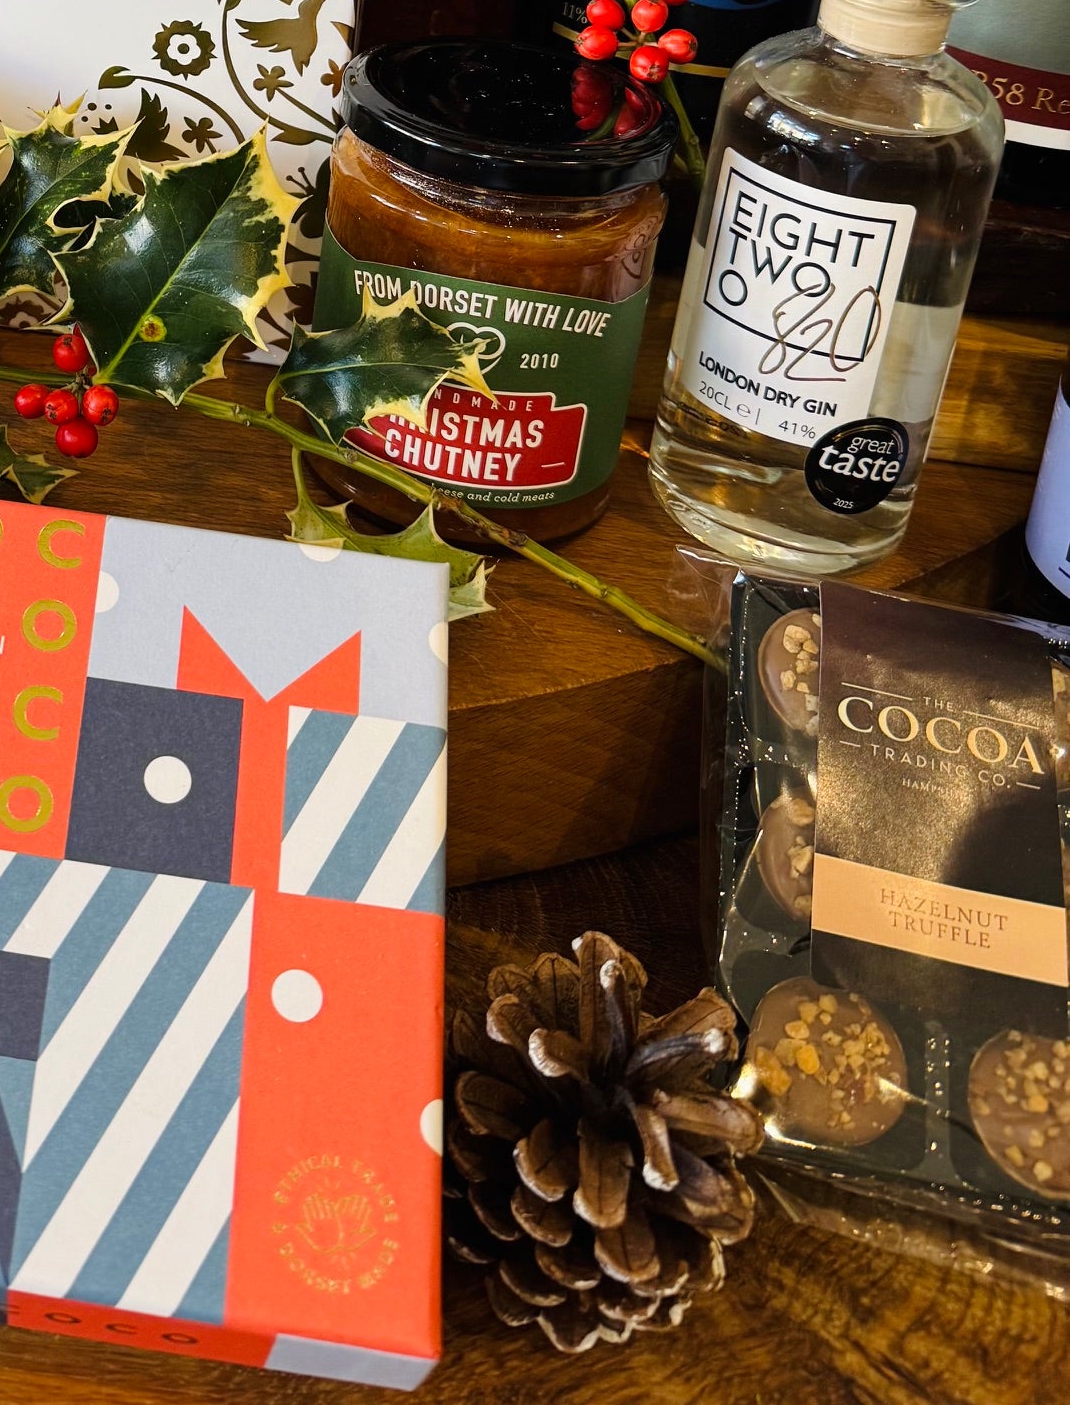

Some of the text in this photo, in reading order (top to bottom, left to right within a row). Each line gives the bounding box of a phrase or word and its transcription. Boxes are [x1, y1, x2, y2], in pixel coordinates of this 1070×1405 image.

[732, 190, 875, 268] EIGHT
[729, 226, 831, 298] TWO
[354, 269, 611, 338] FROM DORSET WITH LOVE
[520, 353, 560, 369] 2010
[699, 350, 837, 418] LONDON DRY GIN
[699, 381, 816, 440] 20CL 41%
[385, 428, 522, 482] CHUTNEY
[819, 445, 900, 483] taste
[847, 437, 896, 454] great
[467, 491, 555, 502] and cold meats
[833, 497, 854, 509] 2025
[923, 697, 954, 712] THE
[837, 696, 1045, 774] COCOA
[871, 744, 1012, 789] TRADING CO.
[881, 889, 1008, 931] HAZELNUT
[889, 911, 990, 949] TRUFFLE
